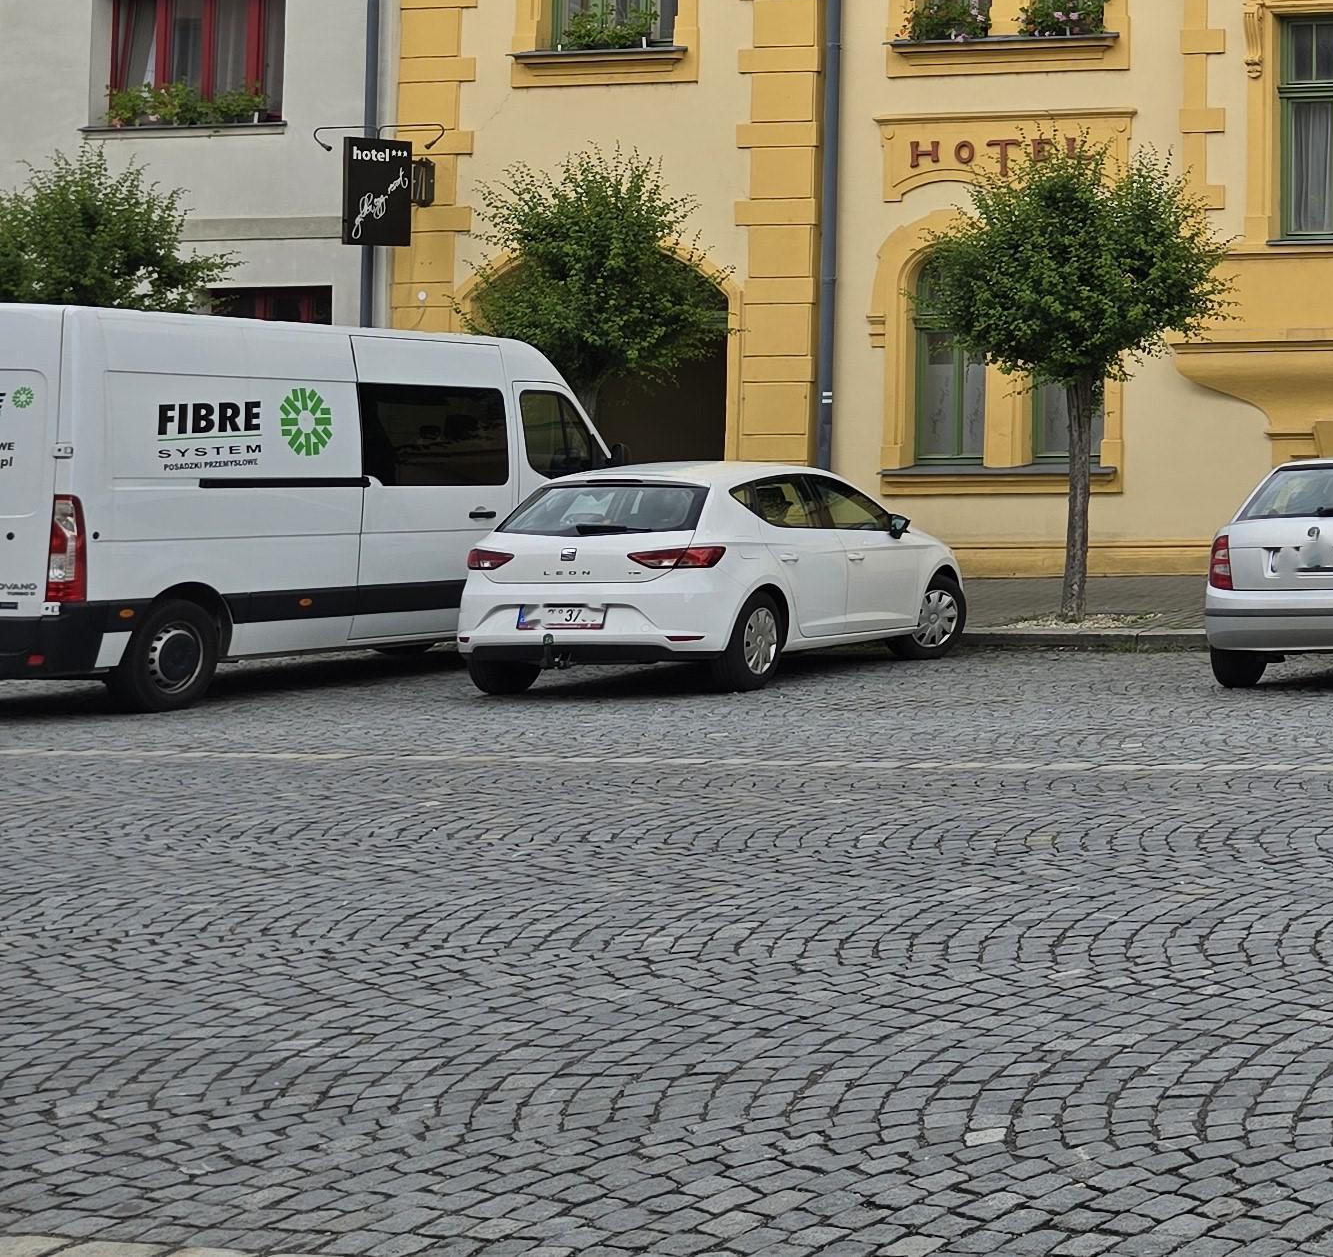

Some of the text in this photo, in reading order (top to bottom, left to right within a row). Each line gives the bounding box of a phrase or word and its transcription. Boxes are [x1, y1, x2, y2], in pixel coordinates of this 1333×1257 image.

[352, 146, 390, 162] hotel
[909, 137, 1094, 178] HOTEL
[157, 400, 262, 436] FIBRE
[158, 444, 262, 459] SYSTEM
[163, 461, 203, 471] POSADZKI
